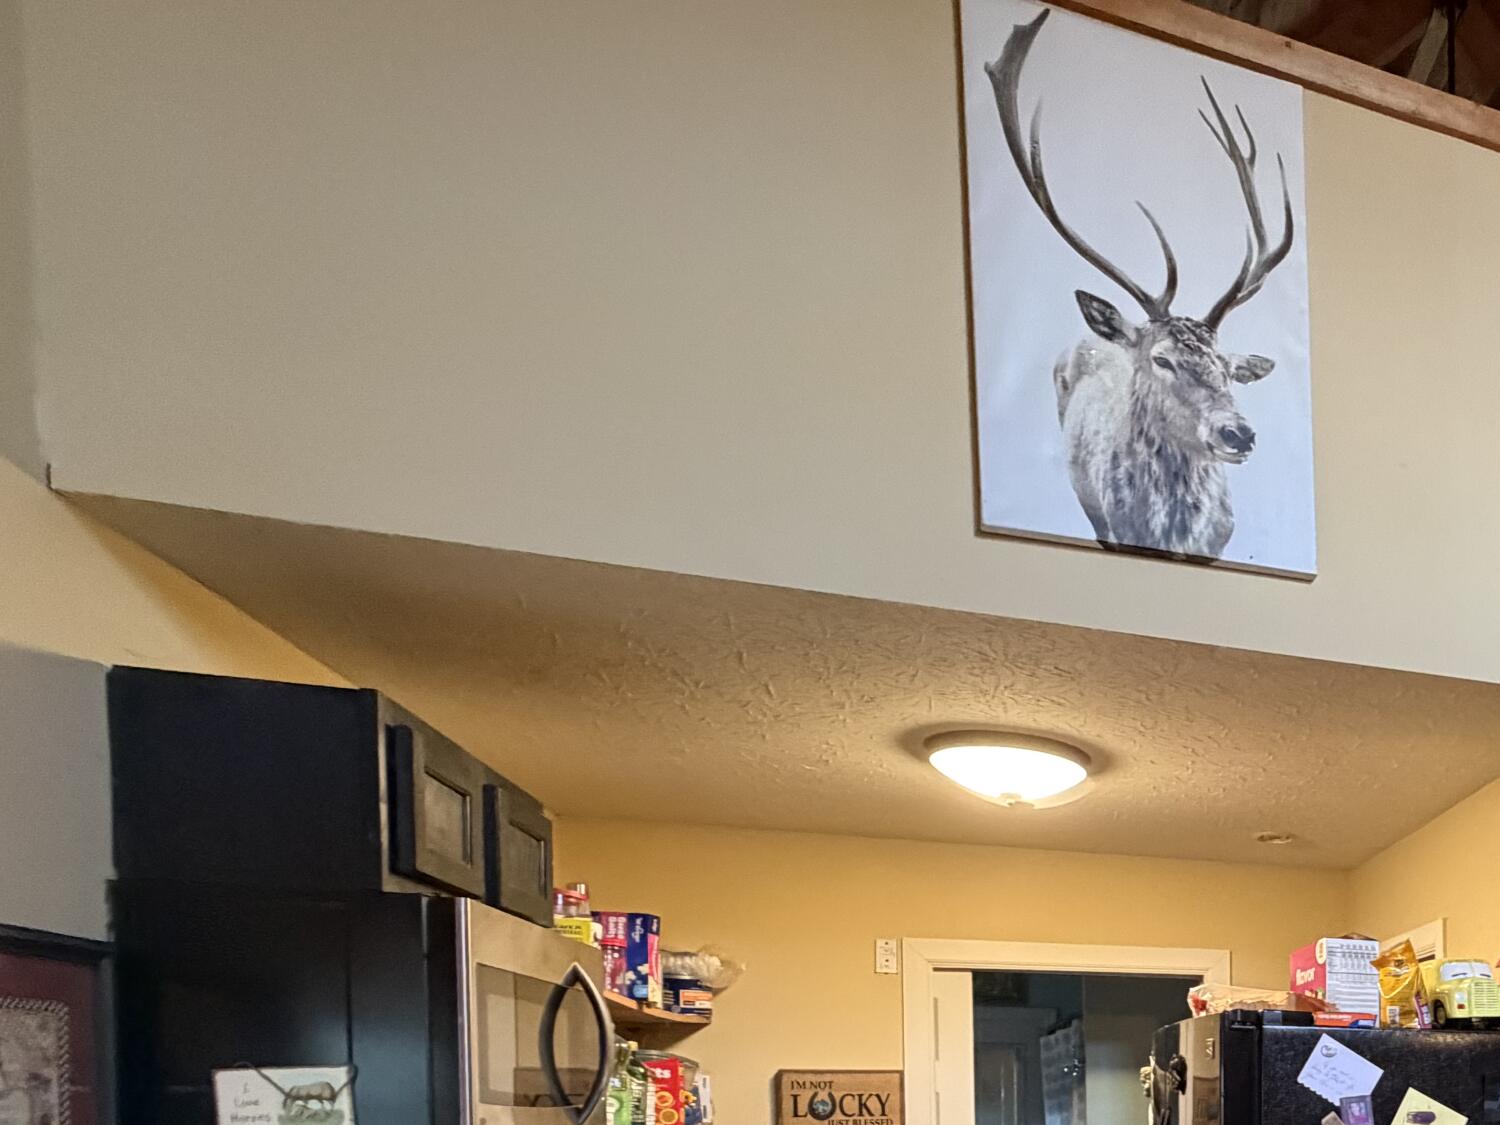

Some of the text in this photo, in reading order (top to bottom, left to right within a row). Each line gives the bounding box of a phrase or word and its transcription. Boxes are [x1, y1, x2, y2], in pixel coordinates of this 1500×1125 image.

[790, 1080, 834, 1090] I'M NOT
[790, 1091, 891, 1121] LUCKY
